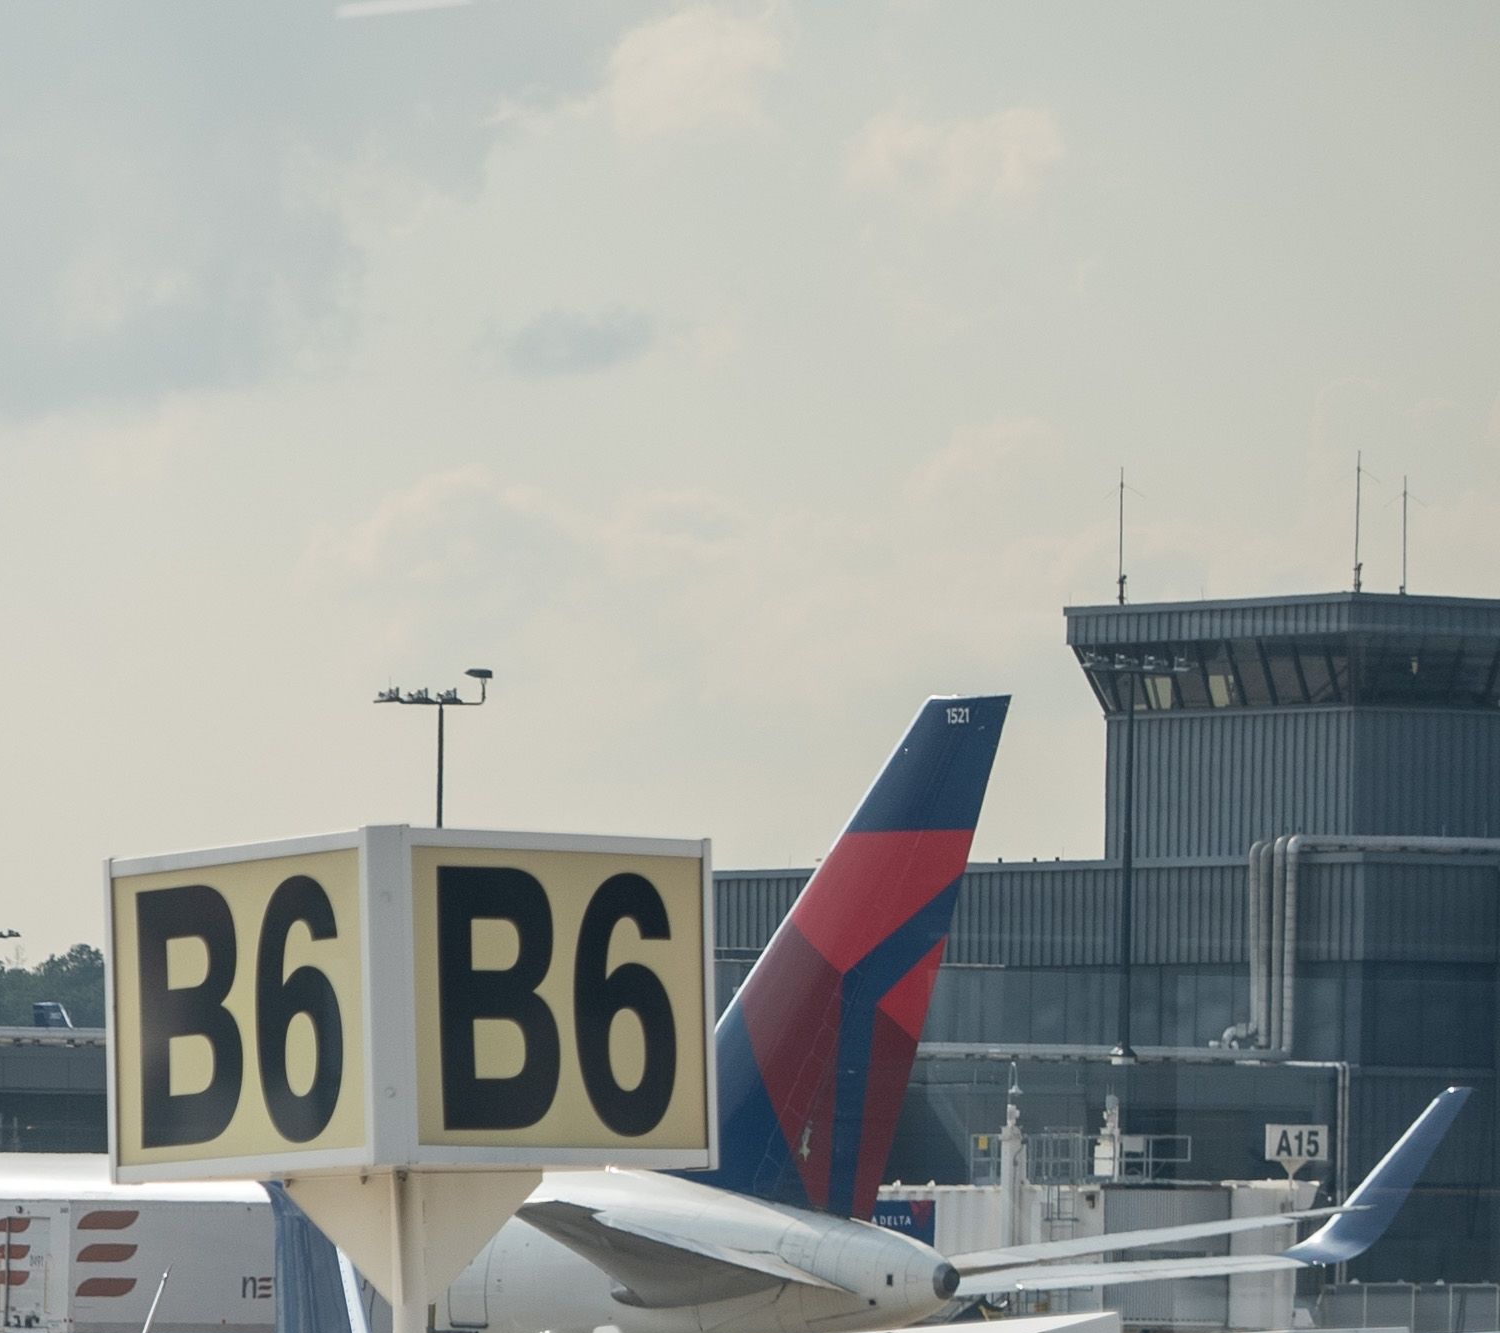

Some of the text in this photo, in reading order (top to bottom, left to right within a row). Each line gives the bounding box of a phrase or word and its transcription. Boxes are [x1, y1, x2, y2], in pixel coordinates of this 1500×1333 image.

[946, 708, 970, 724] 1521
[136, 875, 343, 1149] B6
[437, 866, 676, 1137] B6
[1276, 1130, 1319, 1157] A15
[880, 1215, 912, 1226] DELTA
